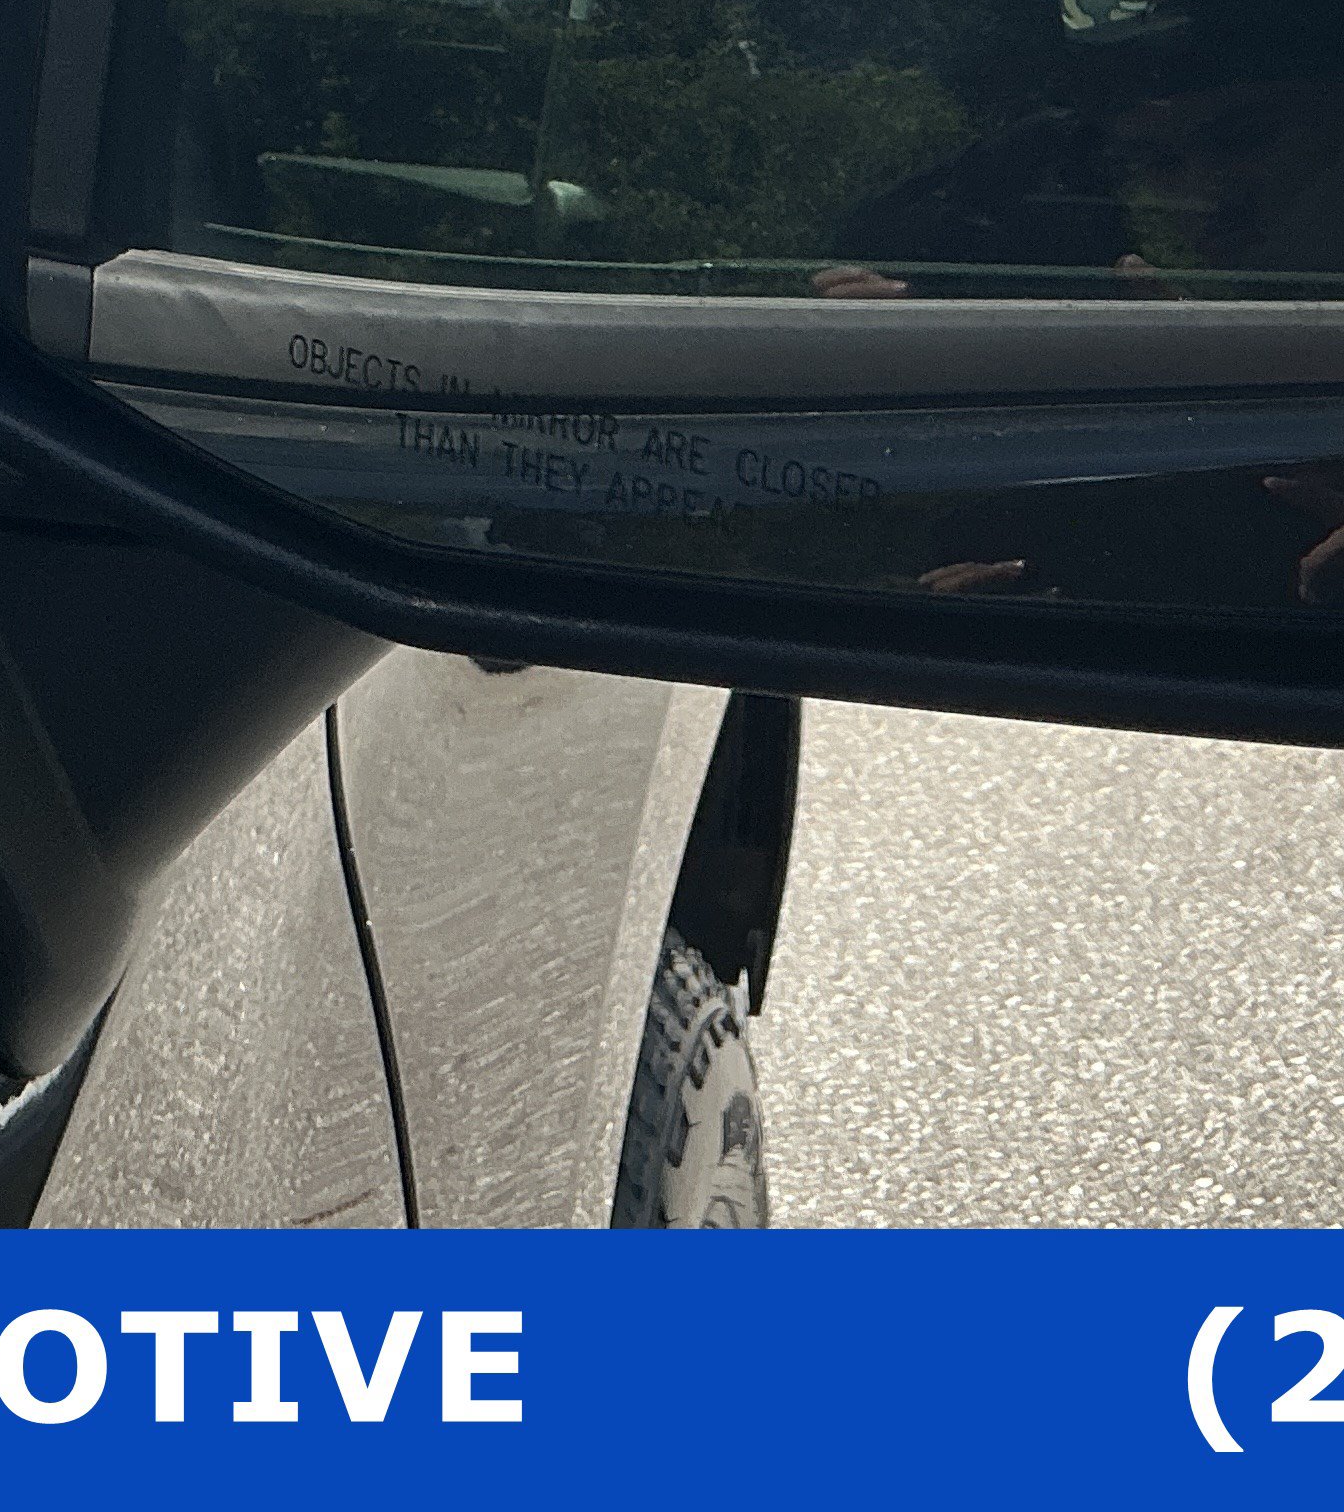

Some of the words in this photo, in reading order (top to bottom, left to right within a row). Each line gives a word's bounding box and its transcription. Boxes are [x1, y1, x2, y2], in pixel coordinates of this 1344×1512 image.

[287, 333, 421, 391] OBJECTS
[641, 426, 712, 476] ARE
[735, 448, 882, 514] CLOSER
[396, 412, 480, 469] THAN
[502, 441, 590, 496] THEY
